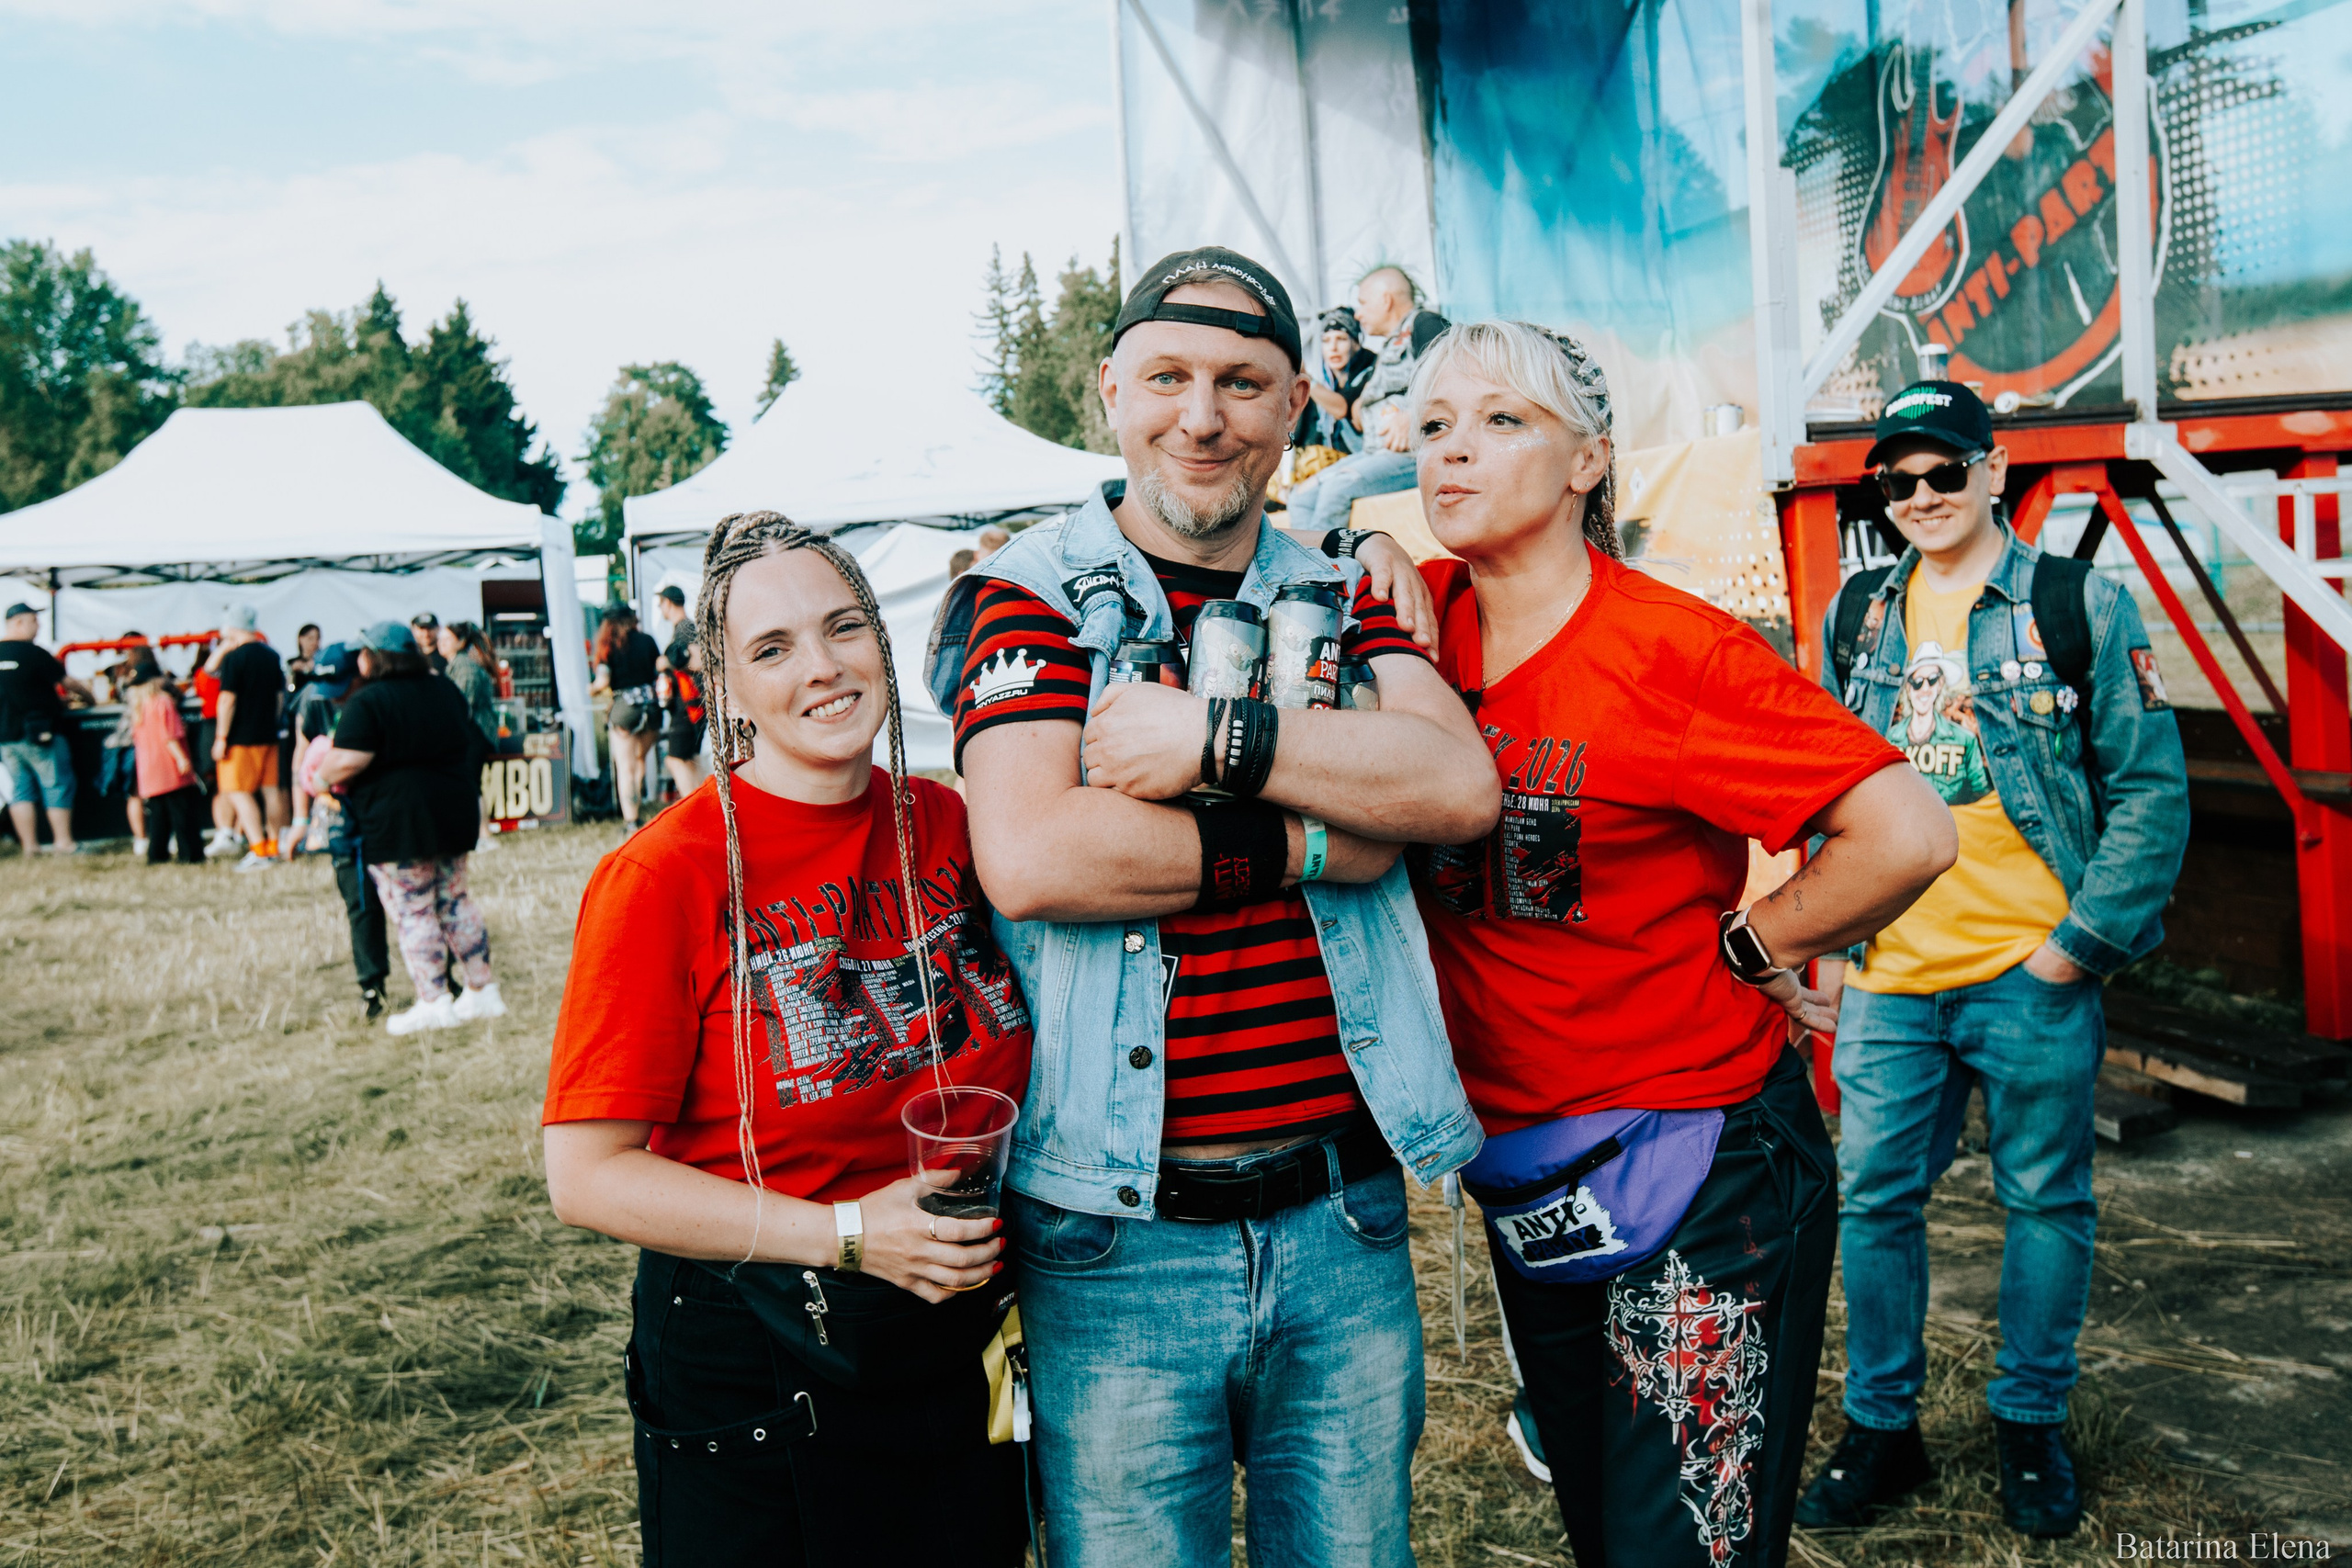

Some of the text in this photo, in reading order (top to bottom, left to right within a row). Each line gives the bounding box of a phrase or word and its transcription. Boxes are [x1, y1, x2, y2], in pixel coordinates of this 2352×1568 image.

[1927, 127, 2116, 354] ANTI-PART
[1162, 261, 1207, 284] ПЛАН
[1073, 574, 1124, 603] SUICIDA
[1509, 736, 1588, 796] 2026
[1899, 743, 1965, 776] KOFF
[1517, 795, 1527, 809] 28
[1528, 796, 1549, 812] ИЮНЯ
[903, 919, 954, 953] ВОРЕСЕНЬЕ.
[776, 950, 789, 962] 26
[789, 941, 816, 960] ИЮНЯ
[862, 960, 872, 972] 27
[871, 959, 895, 971] ИЮНЯ
